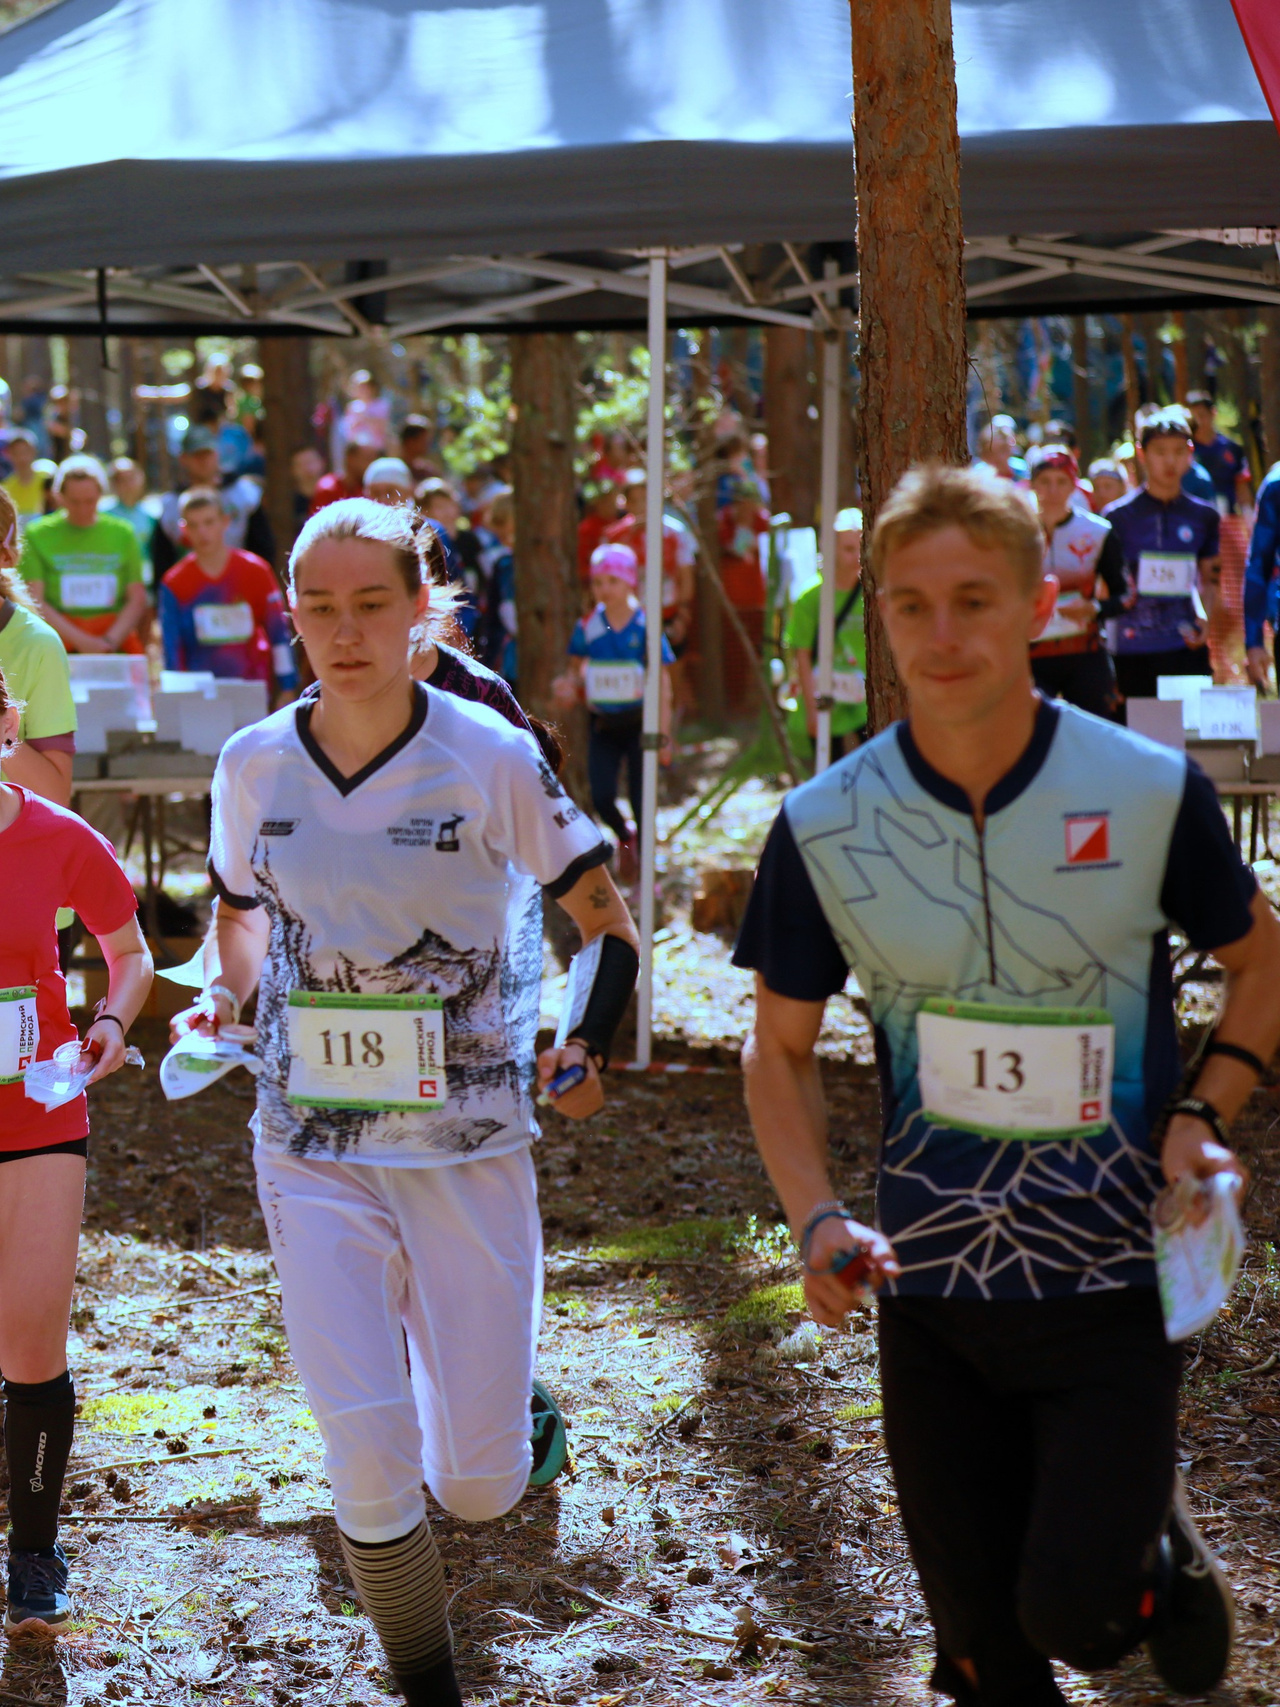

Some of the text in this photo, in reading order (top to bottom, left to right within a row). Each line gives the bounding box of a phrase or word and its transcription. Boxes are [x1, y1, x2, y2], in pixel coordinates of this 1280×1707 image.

[18, 1005, 26, 1053] ПЕРМСКИЙ
[319, 1028, 385, 1068] 118
[413, 1017, 426, 1075] ПЕРМСКИЙ
[427, 1031, 436, 1075] ПЕРИОД
[972, 1047, 1026, 1094] 13
[34, 1431, 47, 1478] NORD
